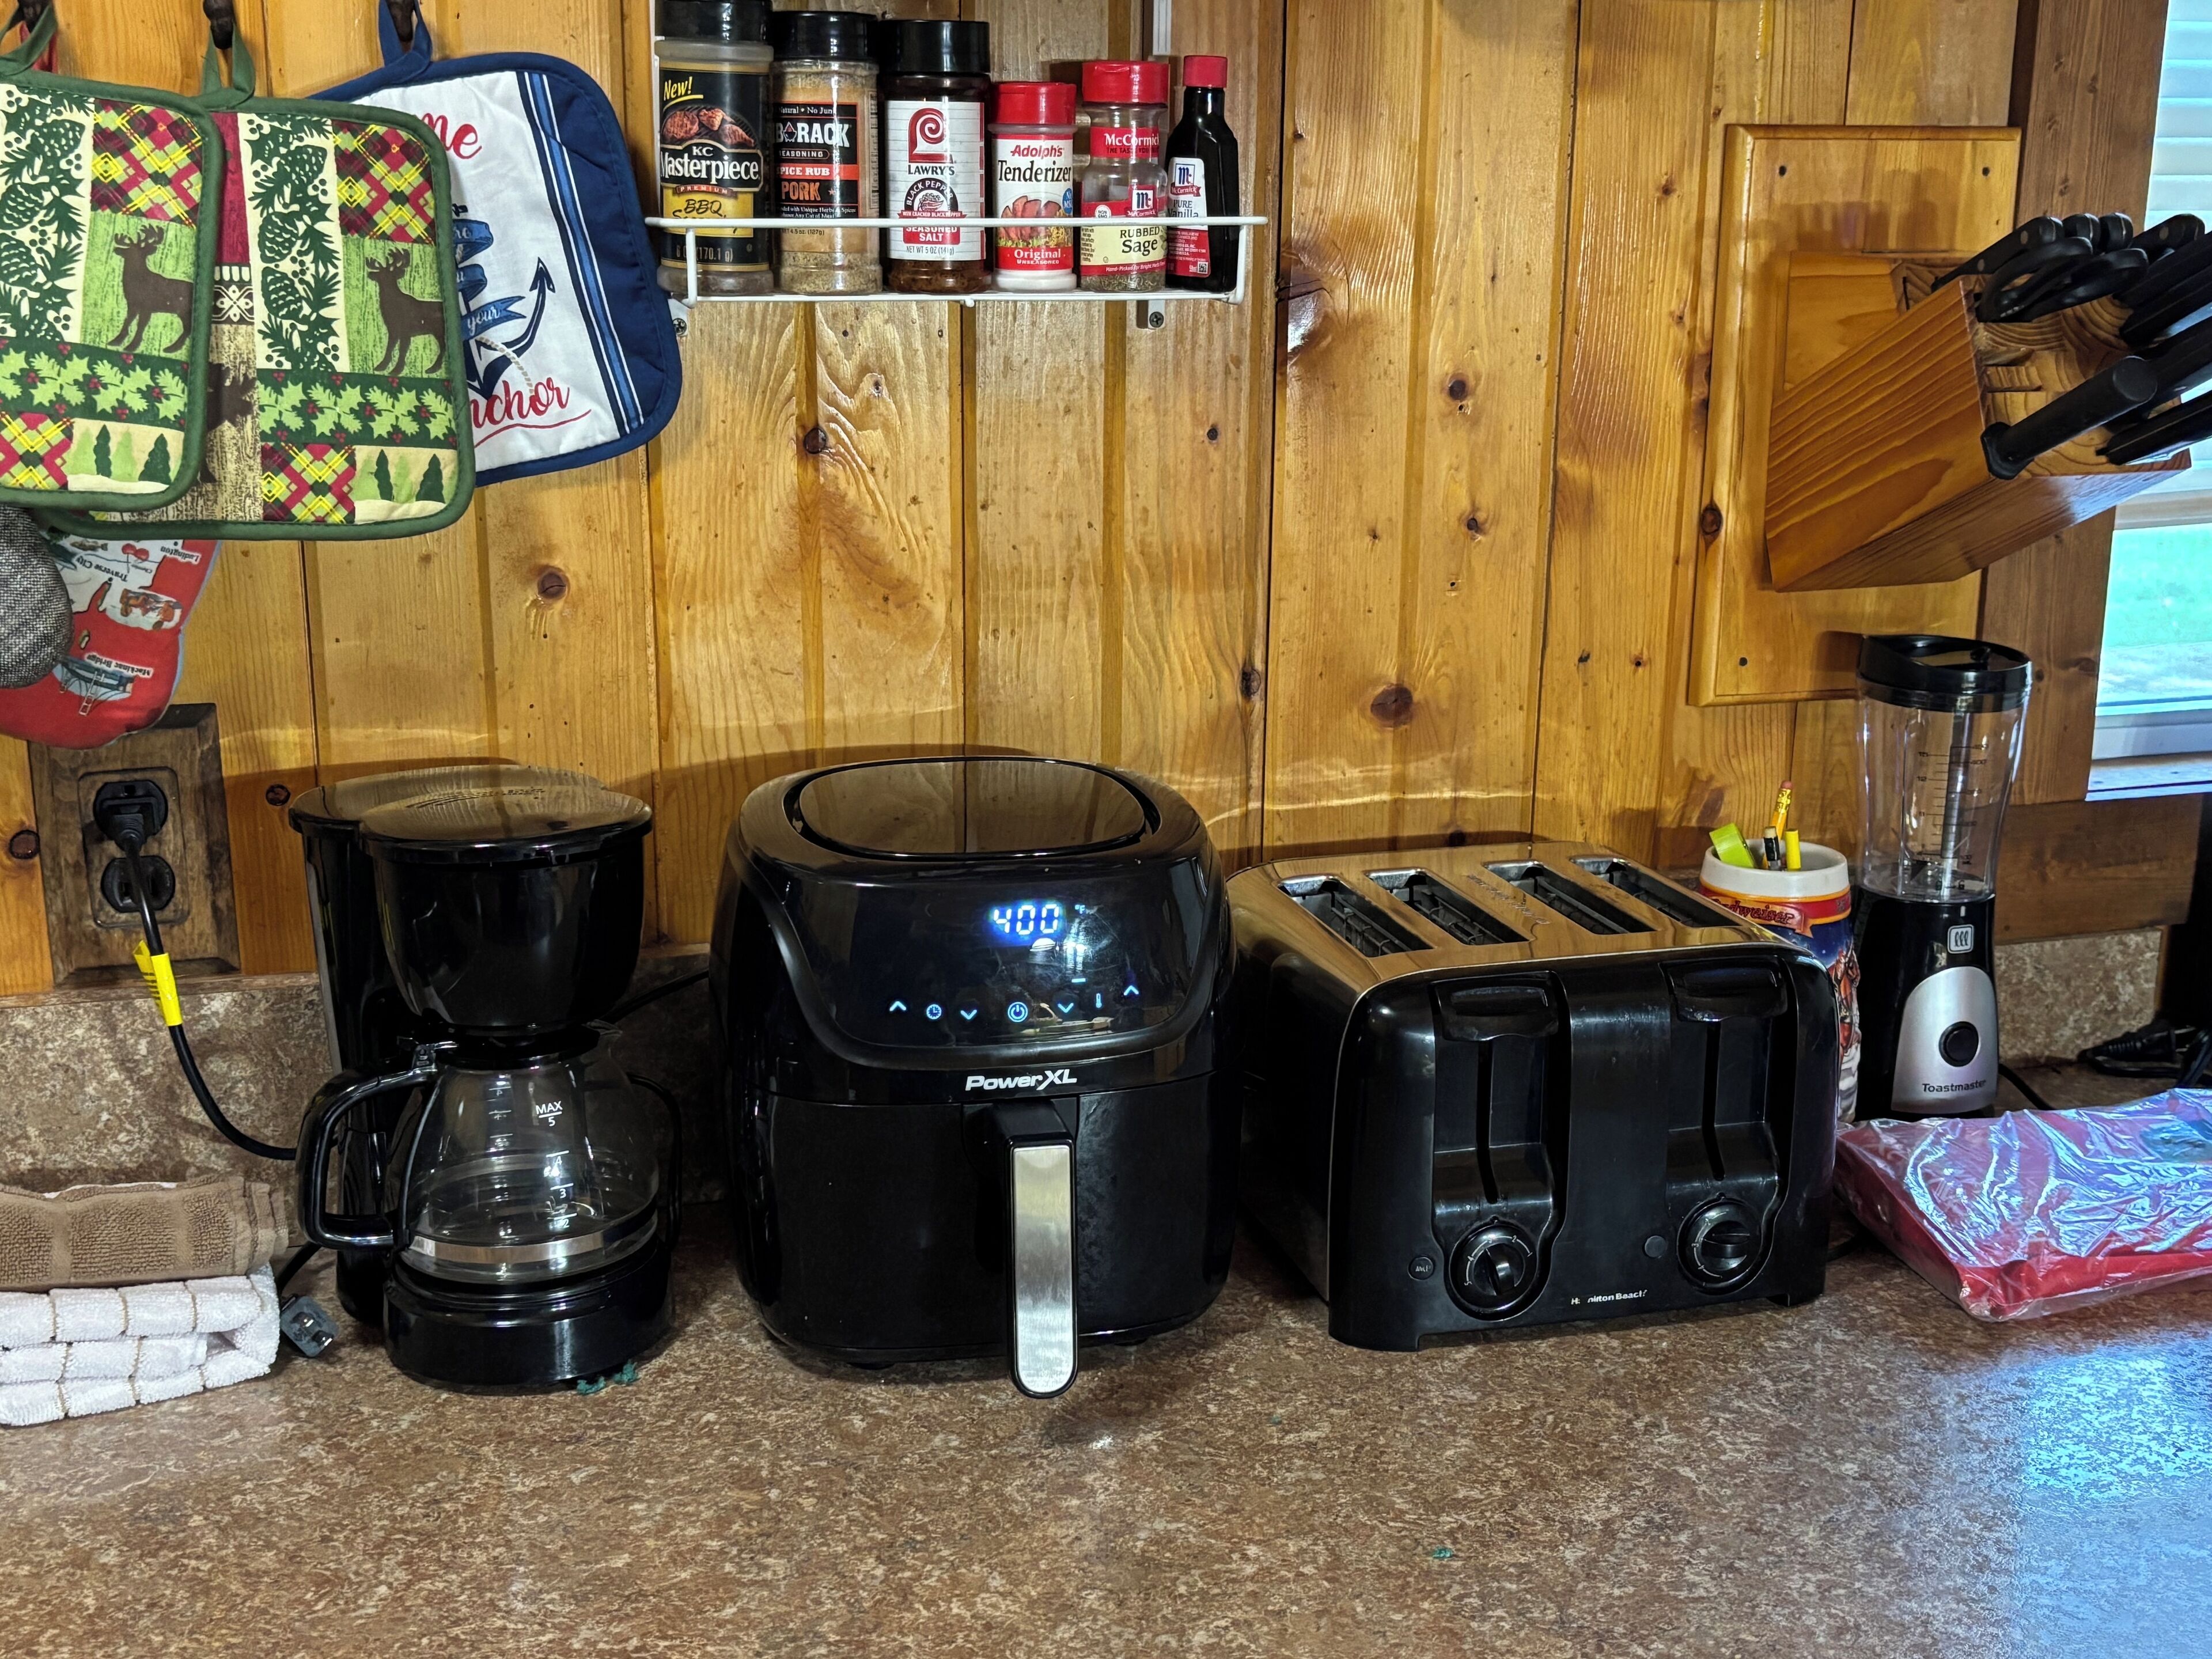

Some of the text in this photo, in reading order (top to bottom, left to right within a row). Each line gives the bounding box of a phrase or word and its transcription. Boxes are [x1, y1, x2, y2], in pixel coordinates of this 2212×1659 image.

[664, 76, 693, 101] New!
[422, 112, 482, 160] me
[692, 146, 714, 157] KC
[1010, 145, 1063, 160] Adolph's
[660, 150, 759, 184] Masterpiece
[779, 166, 830, 176] PICE RUB
[907, 164, 955, 176] LAWRY'S
[997, 160, 1072, 183] Tenderizer
[680, 185, 728, 195] PREMIUM
[781, 181, 821, 201] PORK
[906, 180, 954, 206] BLACK PEPPER
[1171, 185, 1197, 194] McCormick
[684, 198, 722, 218] BBQ
[1173, 199, 1192, 209] PURE
[1168, 208, 1199, 218] Vanilla
[919, 233, 944, 242] SALT
[1119, 226, 1160, 239] RUBBED
[906, 245, 915, 253] NET
[1013, 248, 1061, 260] Original
[1122, 238, 1158, 257] Sage
[467, 306, 501, 334] your
[469, 377, 570, 429] nchor
[160, 546, 200, 562] Ludington
[75, 555, 128, 582] Traverse City
[86, 653, 152, 676] Mackinac Bridge
[1712, 899, 1795, 925] dweiser
[993, 904, 1060, 935] 400
[965, 1069, 1078, 1092] PowerXL
[1922, 1080, 1987, 1093] Toastmaster
[535, 1100, 563, 1115] MAX
[548, 1116, 556, 1127] 5
[555, 1156, 563, 1165] 4
[559, 1188, 567, 1199] 3
[563, 1218, 570, 1228] 2
[1512, 1235, 1517, 1243] 2
[1415, 1264, 1431, 1272] ANCE
